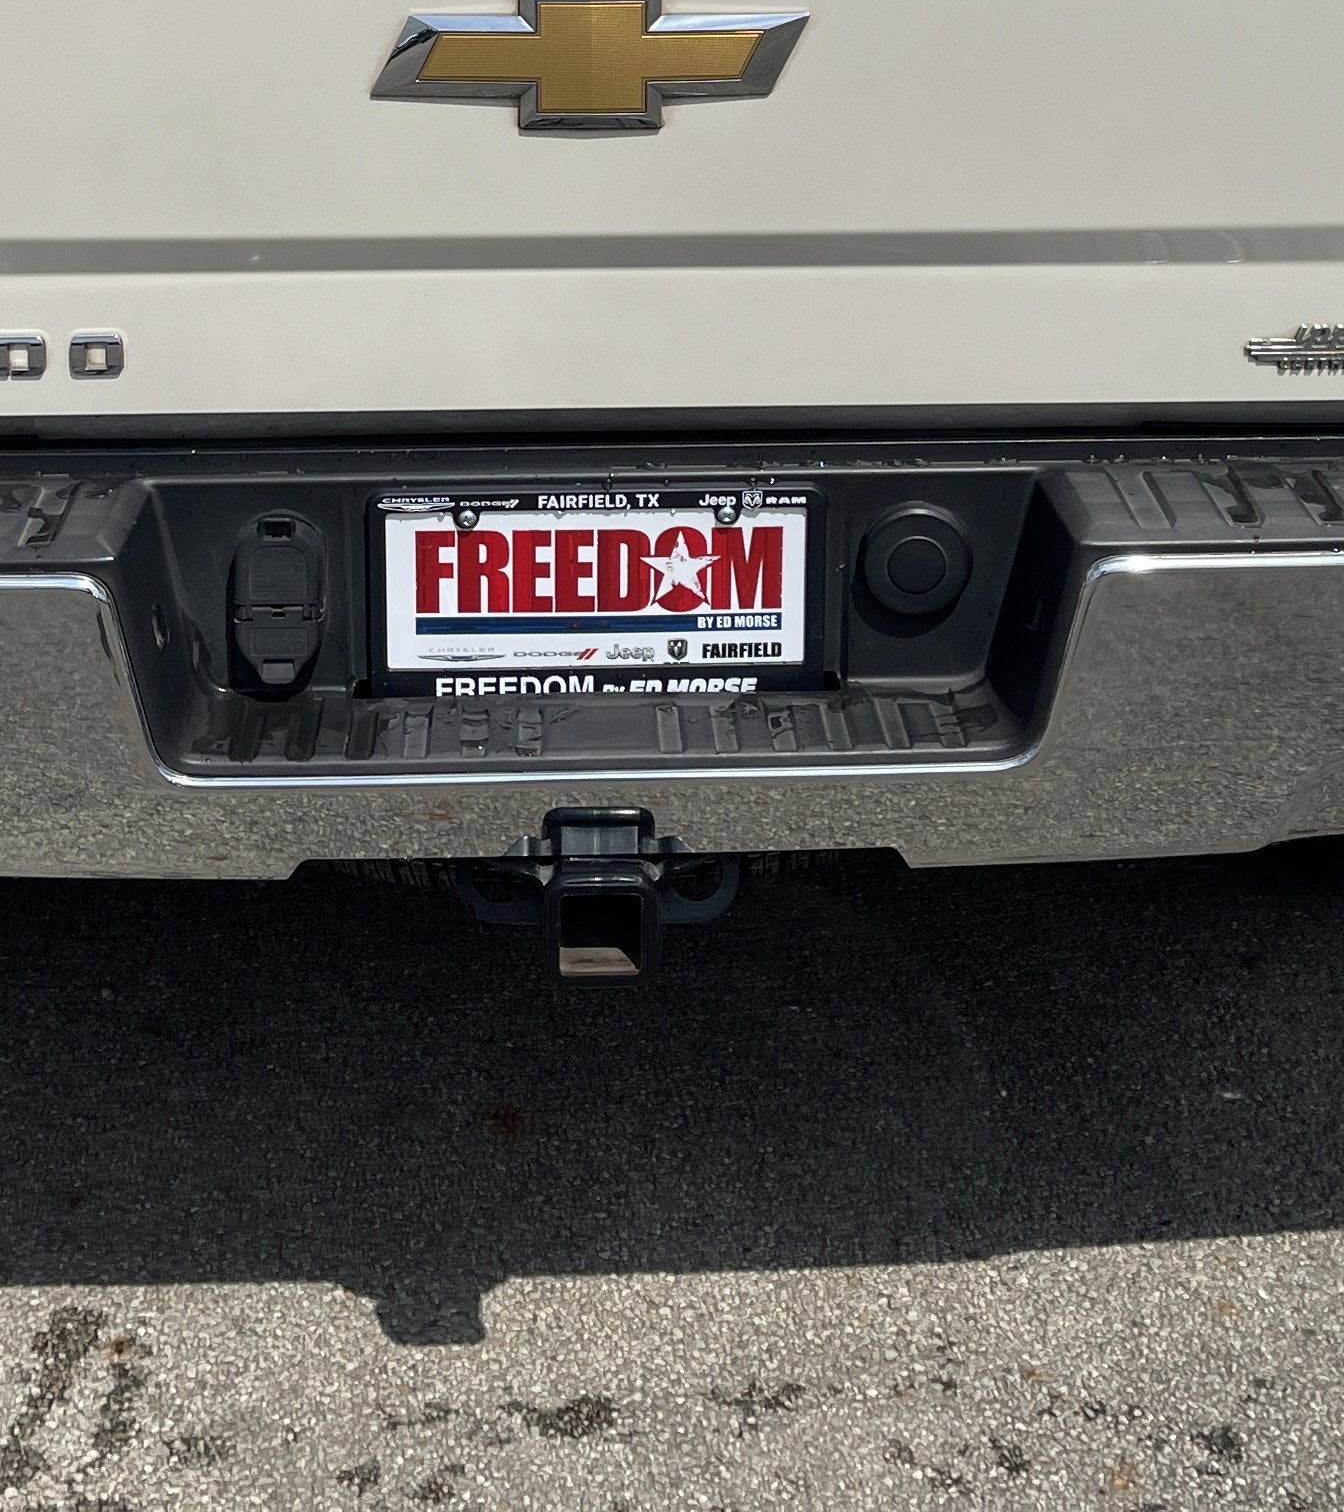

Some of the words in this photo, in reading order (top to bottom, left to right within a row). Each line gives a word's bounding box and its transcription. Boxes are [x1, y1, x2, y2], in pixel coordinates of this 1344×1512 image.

[537, 494, 631, 510] FAIRFIELD,
[636, 494, 660, 508] TX
[699, 494, 737, 507] Jeep
[765, 496, 807, 504] RAM
[414, 526, 784, 614] FREEDOM
[697, 616, 714, 629] BY
[716, 615, 732, 628] ED
[734, 615, 778, 628] MORSE
[606, 644, 655, 661] Jeep
[702, 642, 782, 659] FAIRFIELD
[435, 675, 595, 697] FREEDOM
